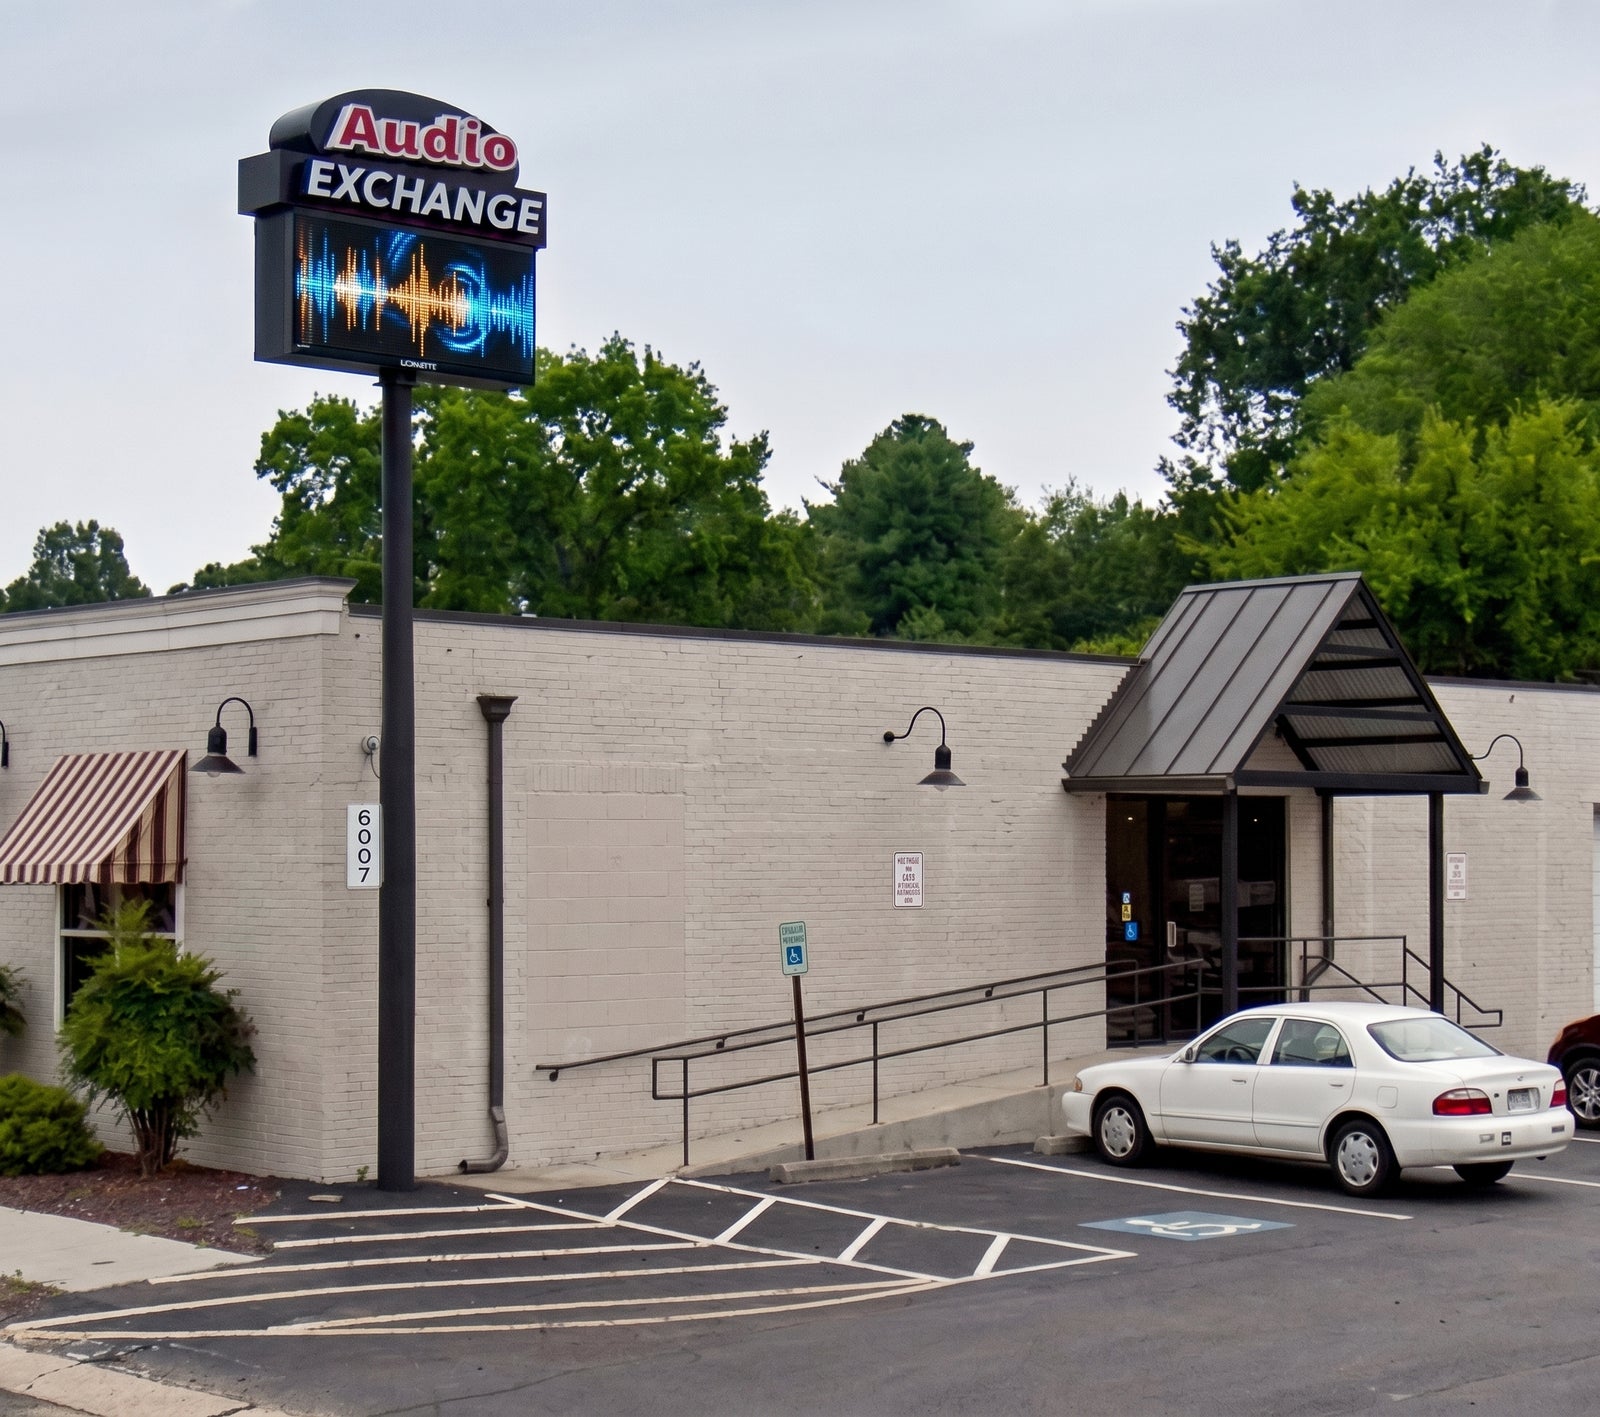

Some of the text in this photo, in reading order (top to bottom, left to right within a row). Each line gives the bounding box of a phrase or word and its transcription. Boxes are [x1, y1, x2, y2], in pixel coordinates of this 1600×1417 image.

[326, 103, 517, 172] Audio
[307, 159, 542, 234] EXCHANGE
[358, 809, 371, 882] 6007
